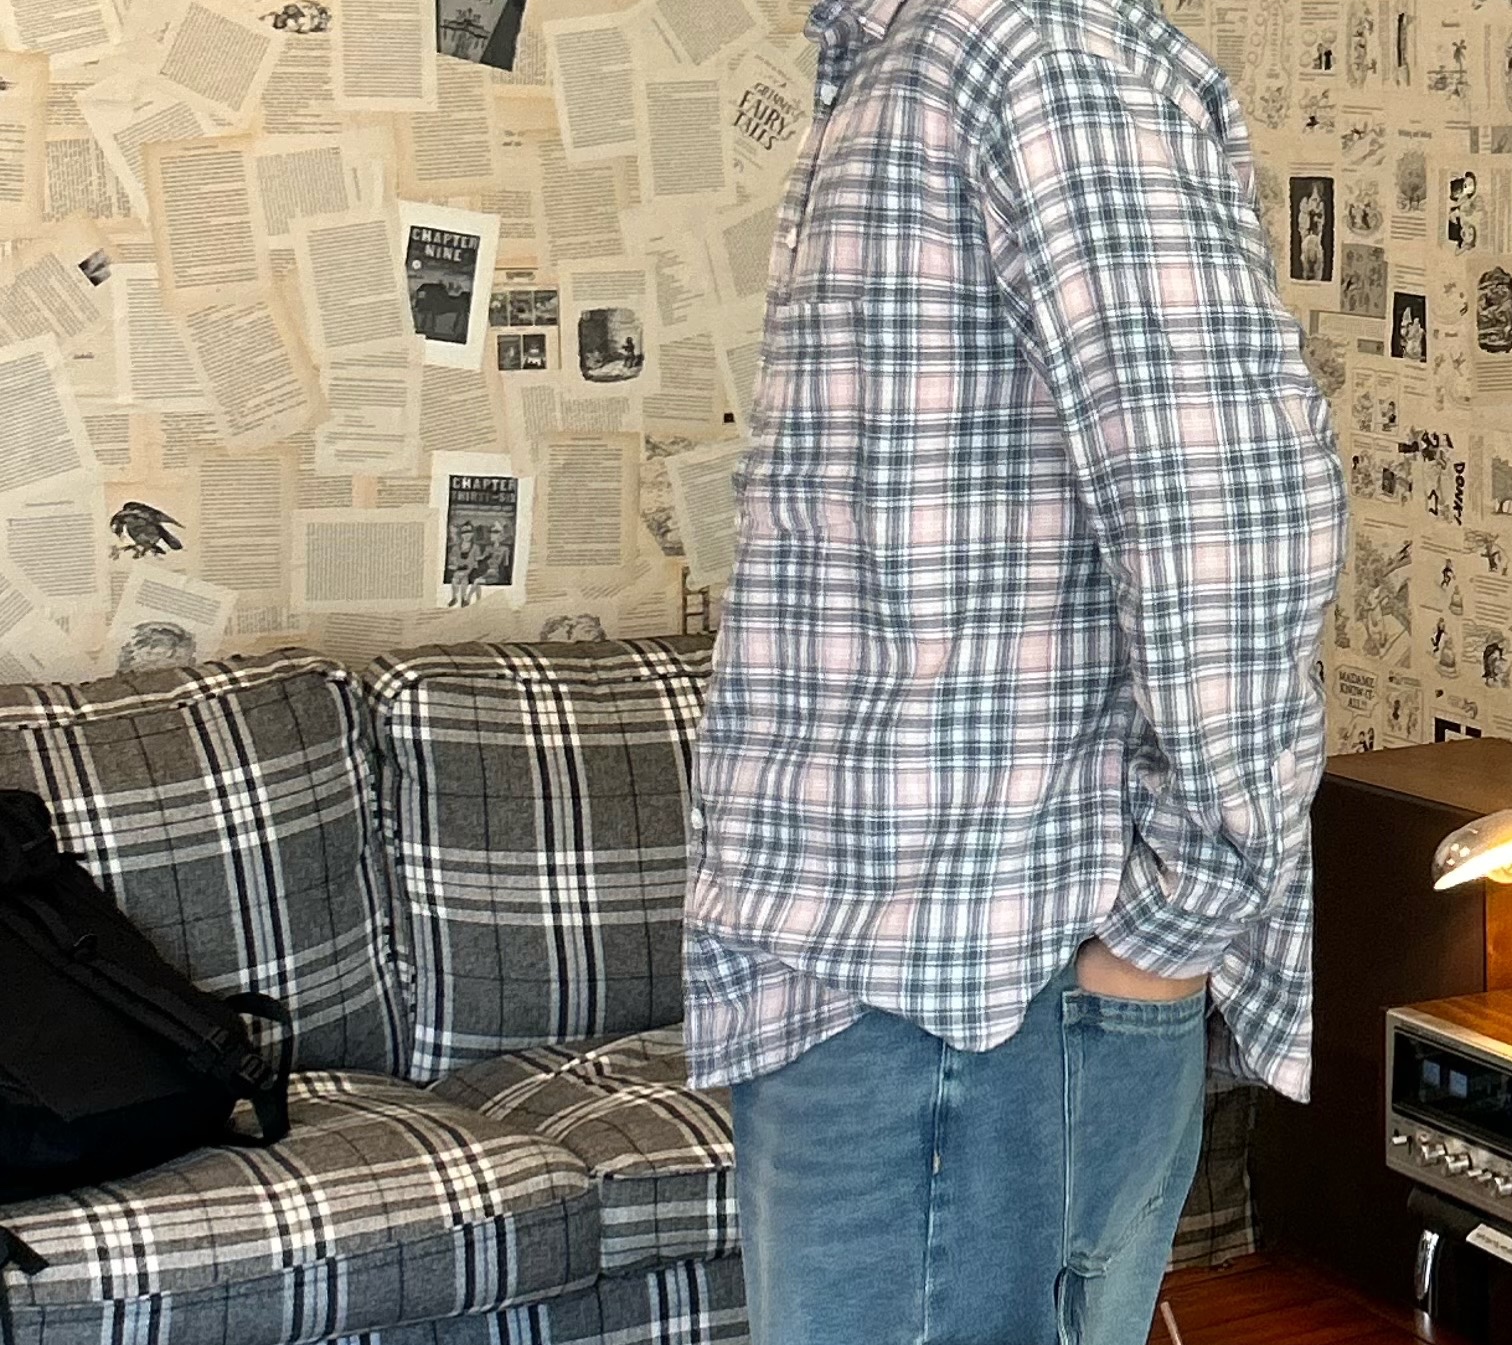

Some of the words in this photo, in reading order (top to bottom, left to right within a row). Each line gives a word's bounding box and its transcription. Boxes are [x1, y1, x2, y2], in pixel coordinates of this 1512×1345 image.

[411, 227, 479, 250] CHAPTER
[424, 243, 462, 262] NINE
[452, 476, 517, 492] CHAPTER
[1452, 461, 1466, 527] DONK!
